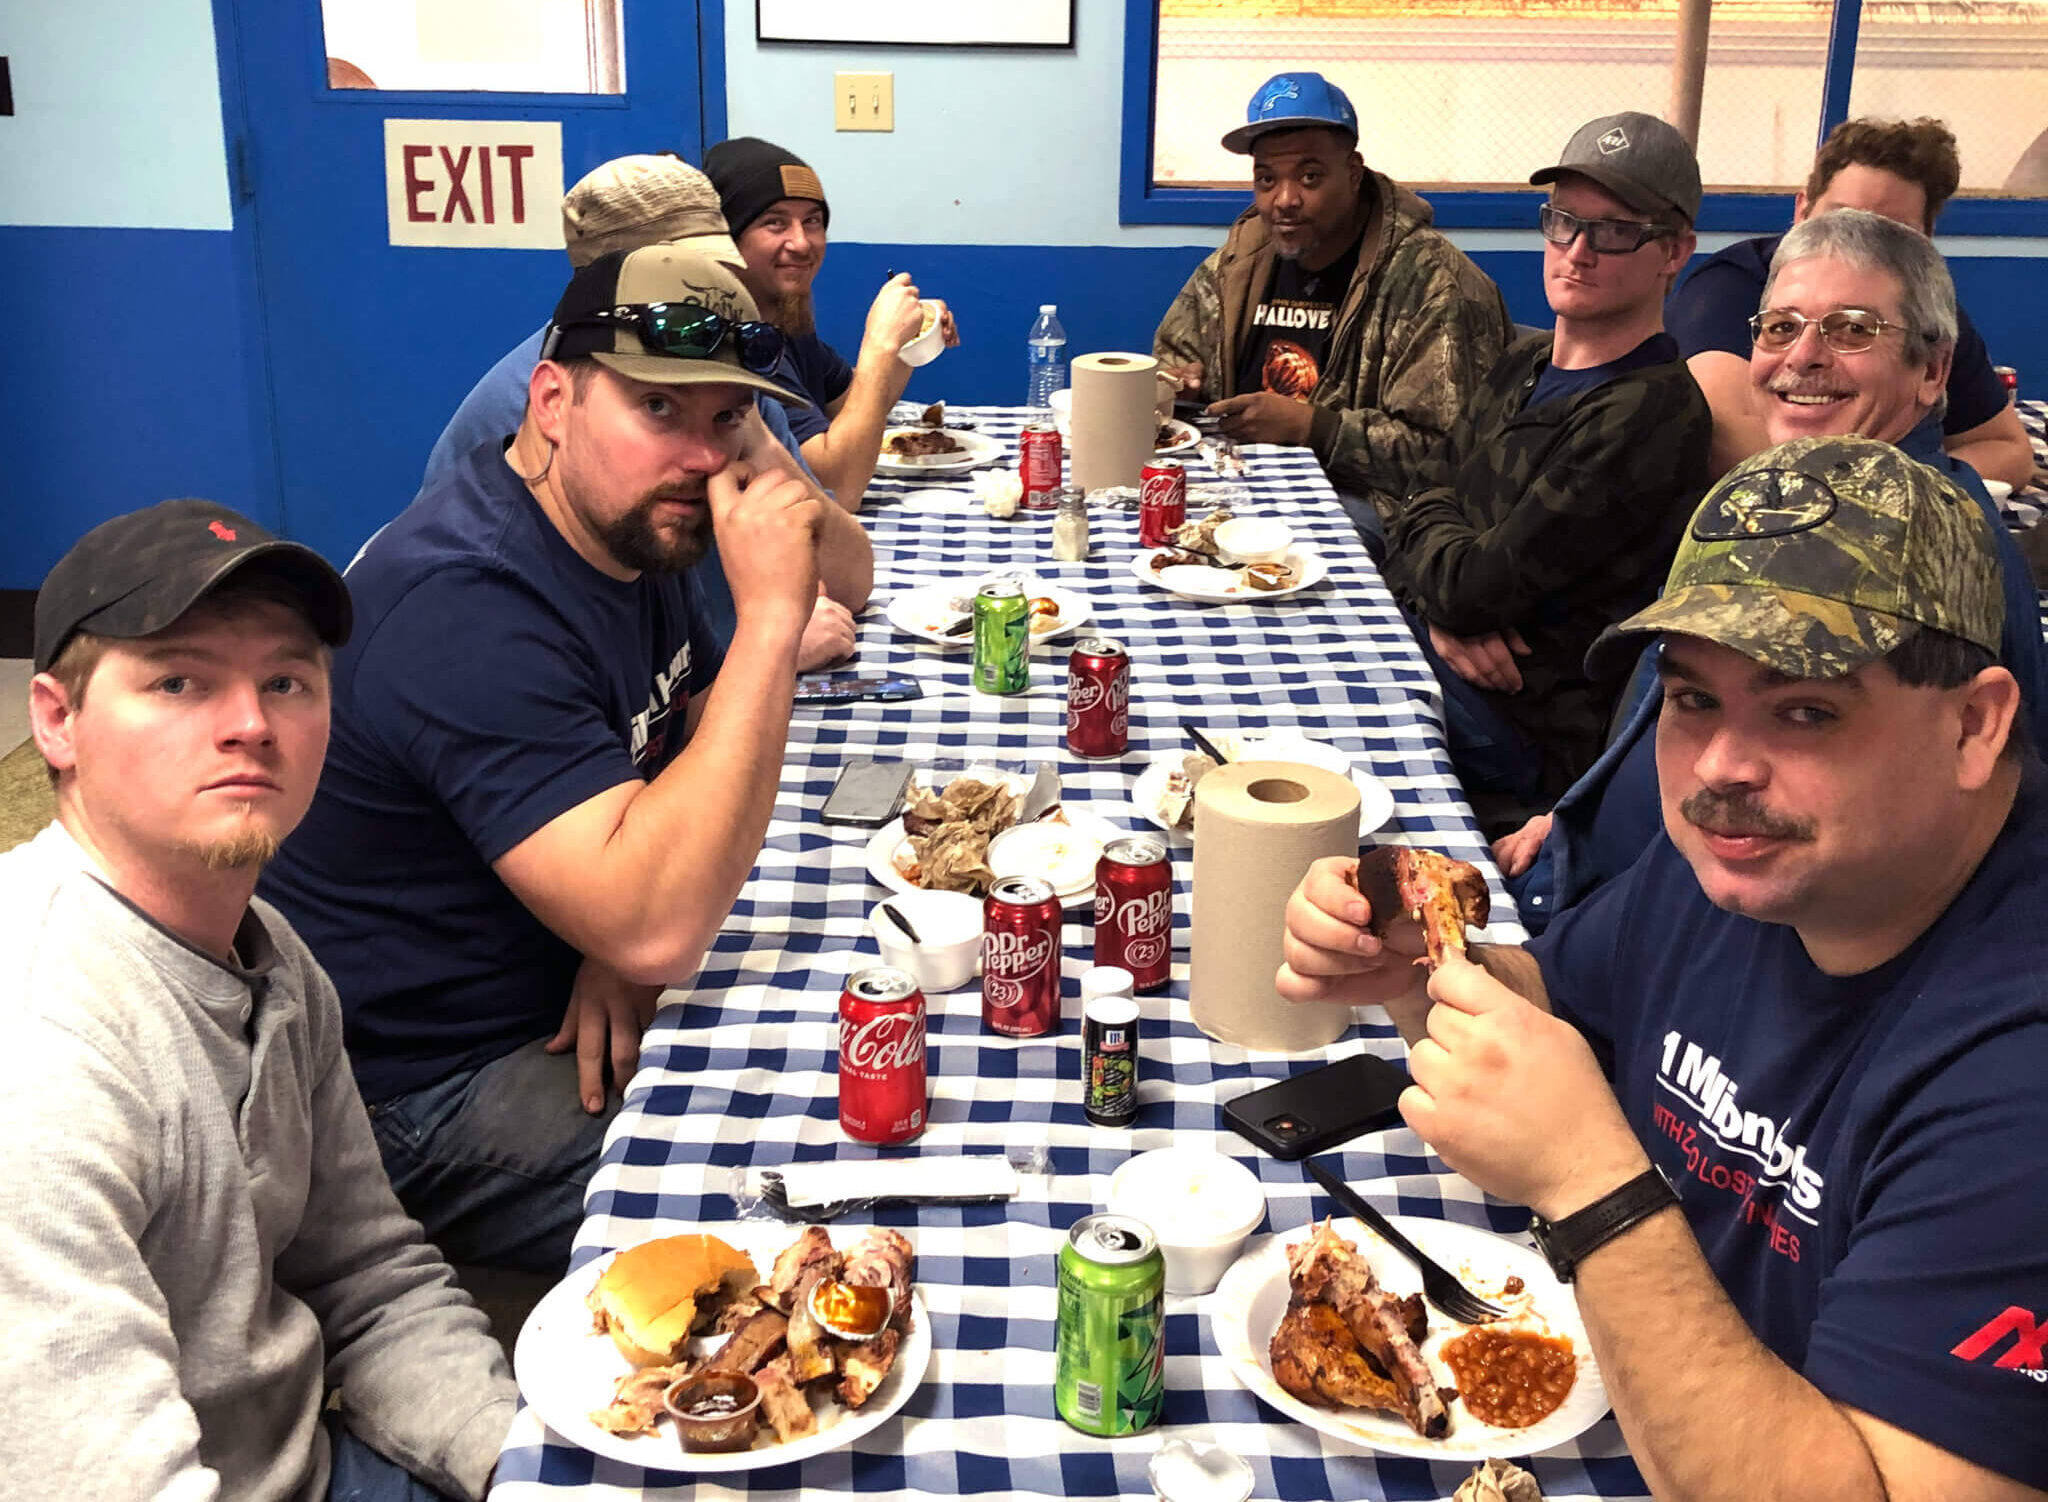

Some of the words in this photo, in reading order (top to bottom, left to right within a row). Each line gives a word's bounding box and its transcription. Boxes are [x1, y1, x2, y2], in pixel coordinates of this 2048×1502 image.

[403, 144, 534, 224] EXIT
[983, 932, 1049, 976] Pepper
[999, 931, 1029, 954] Dr
[1661, 1030, 1682, 1077] 1
